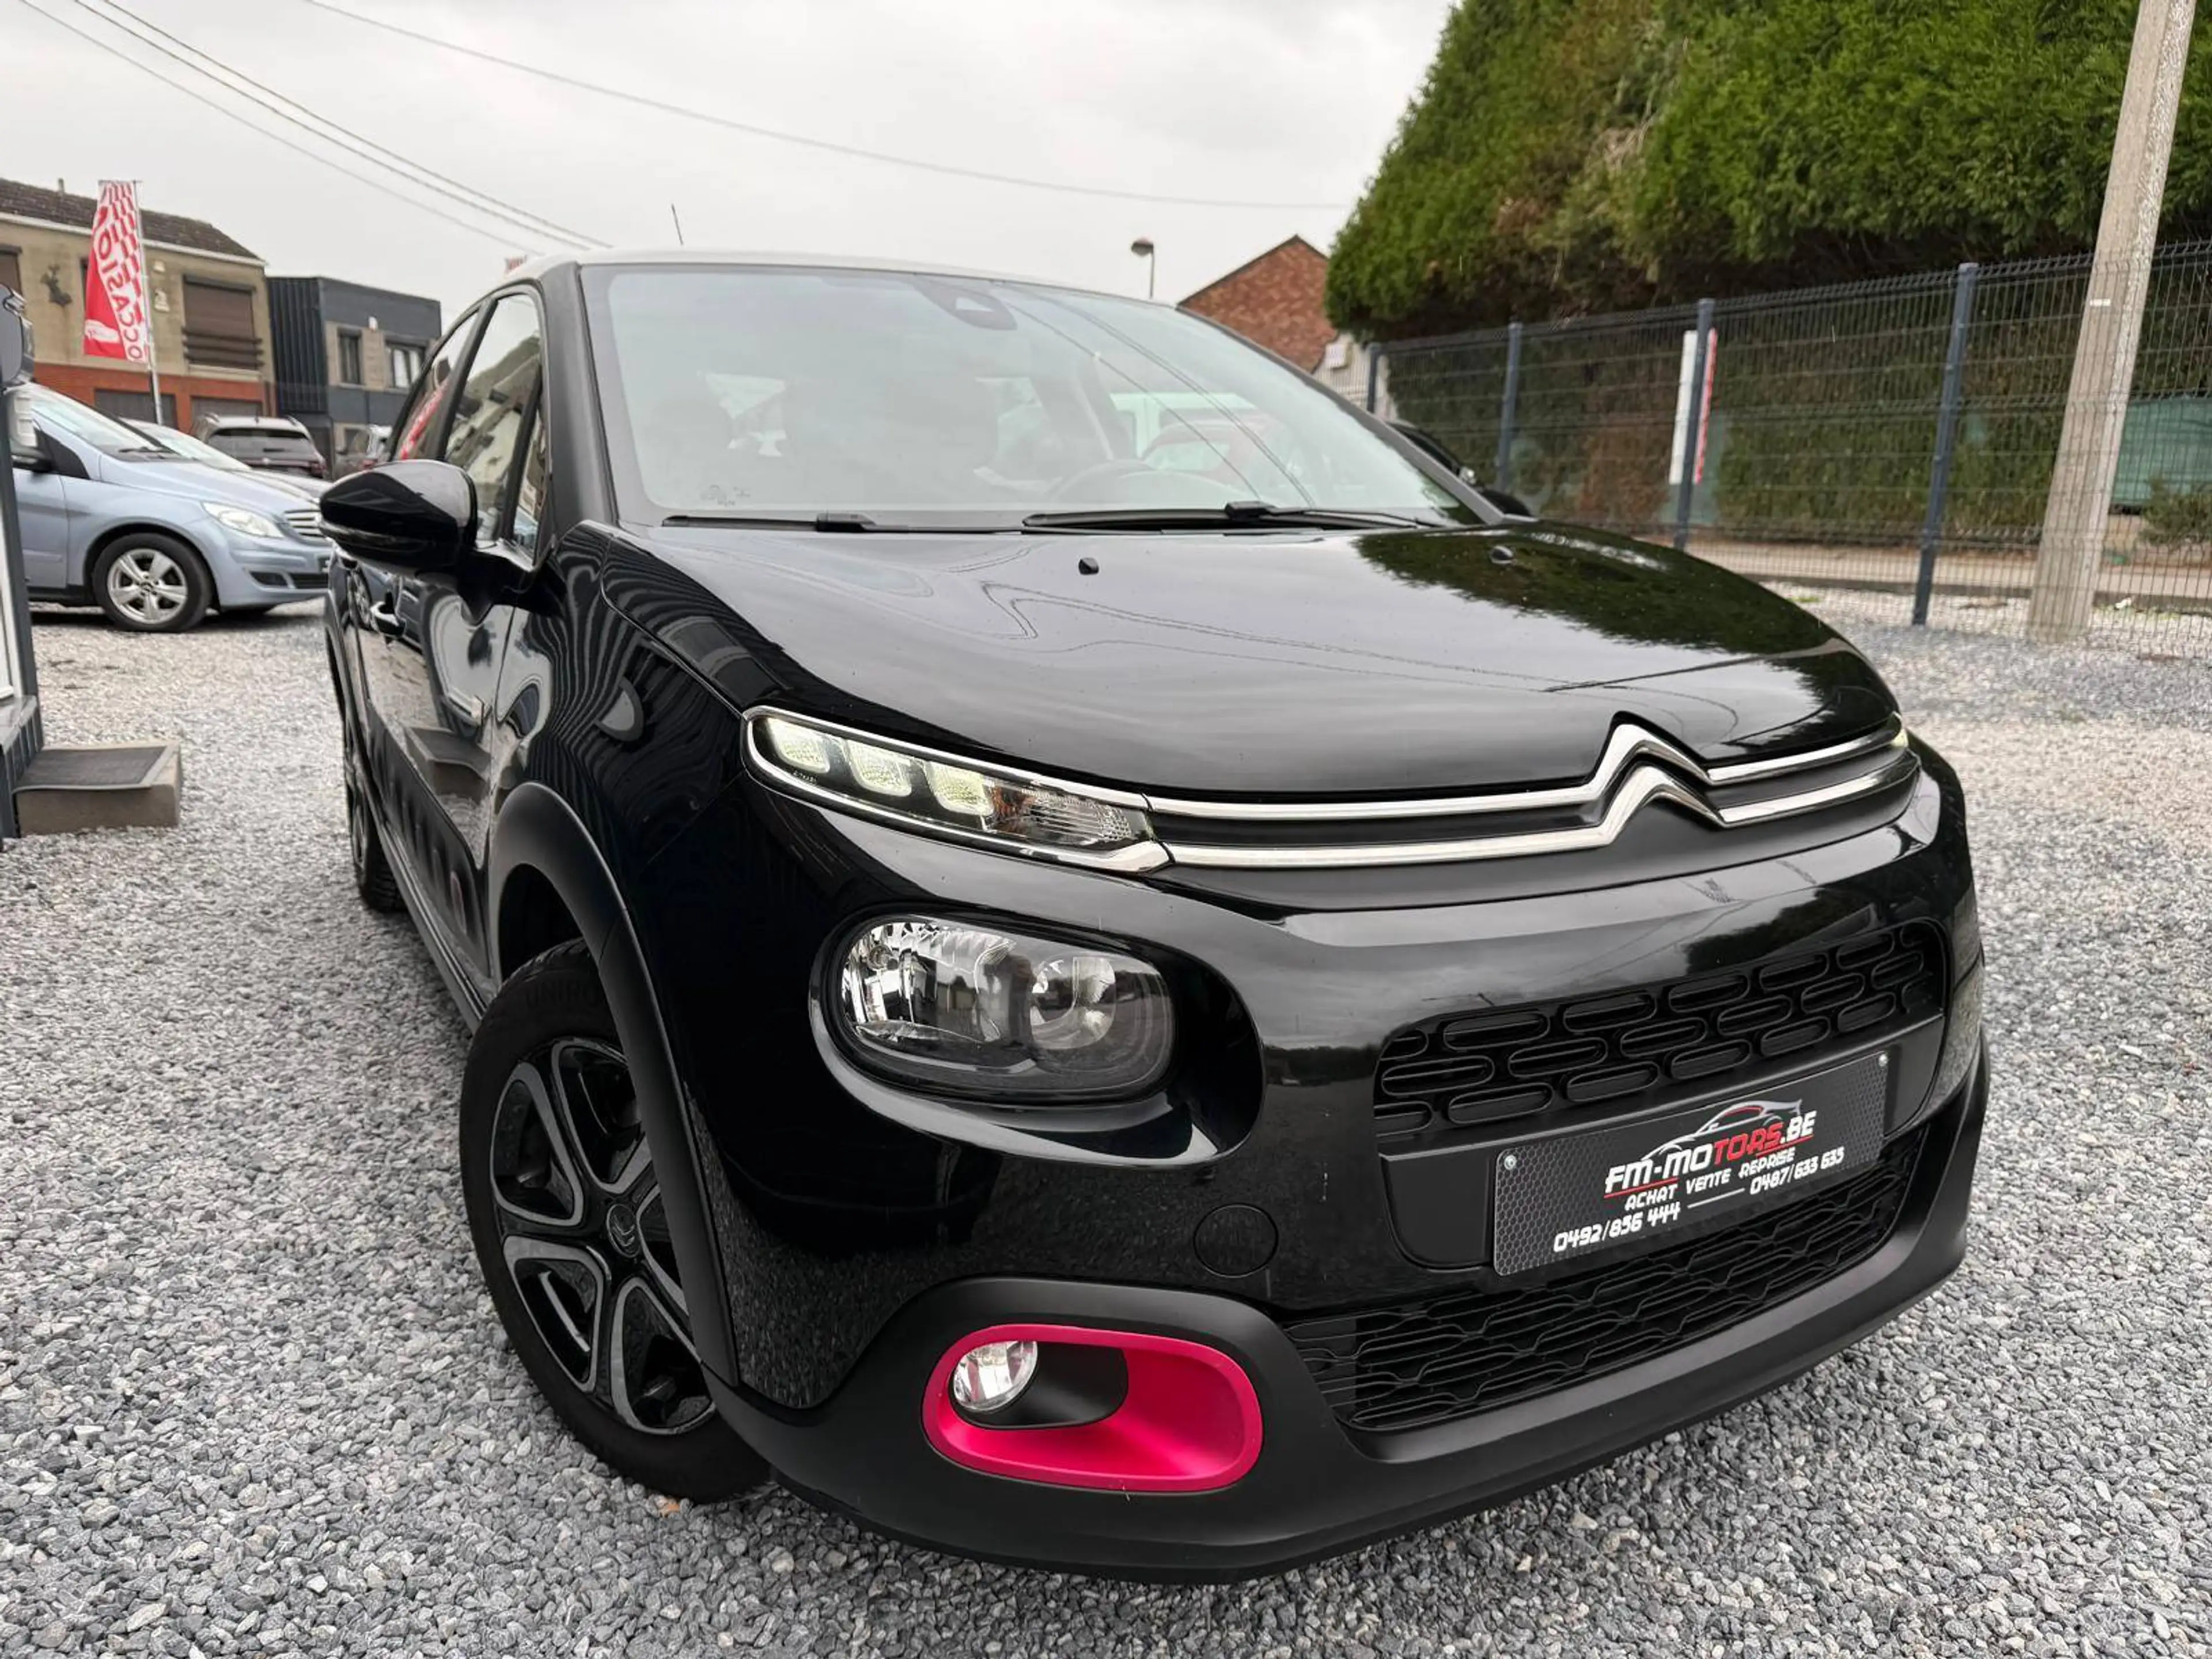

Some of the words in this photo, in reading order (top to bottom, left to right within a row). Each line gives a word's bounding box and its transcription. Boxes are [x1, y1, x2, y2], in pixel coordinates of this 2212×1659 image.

[1605, 1111, 1817, 1194] FM-MOTORS.BE
[1624, 1184, 1678, 1211] ACHAT
[1685, 1168, 1732, 1195] VENTE
[1737, 1146, 1797, 1179] REPRISE
[1646, 1201, 1681, 1227] 444
[1749, 1156, 1819, 1195] 0487/633
[1820, 1146, 1845, 1170] 635
